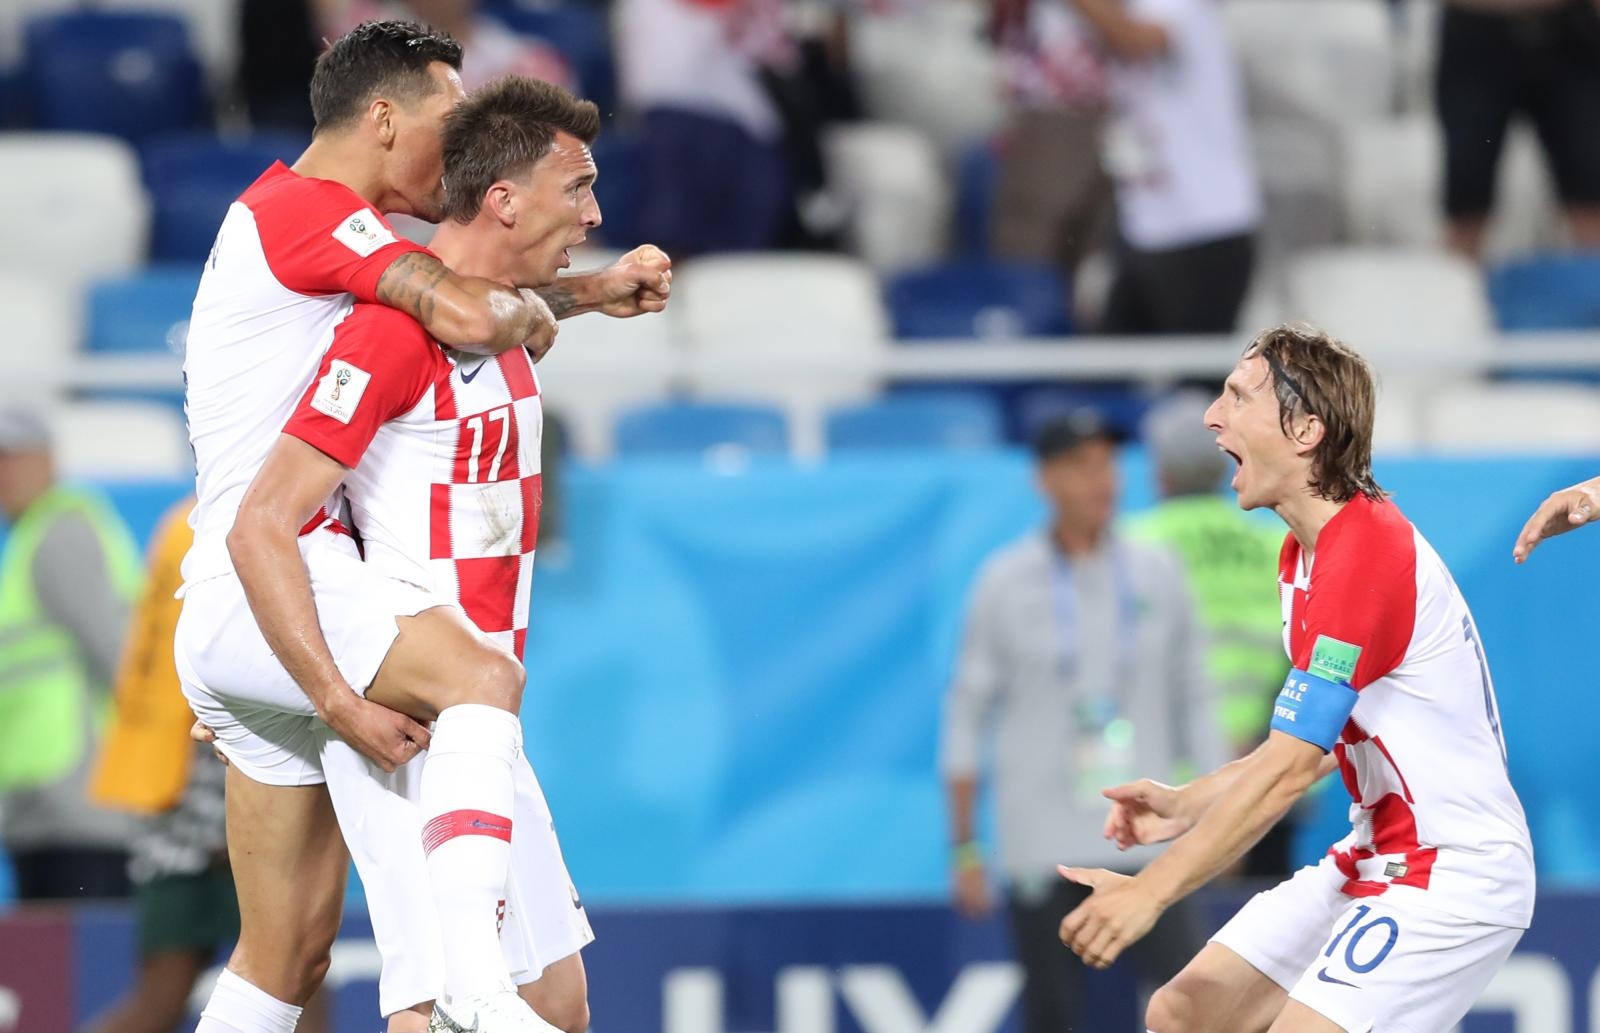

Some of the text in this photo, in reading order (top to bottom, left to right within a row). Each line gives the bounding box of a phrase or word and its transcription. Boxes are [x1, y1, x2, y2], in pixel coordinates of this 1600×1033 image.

[466, 406, 510, 483] 17
[1274, 705, 1297, 721] FIFA
[1324, 904, 1399, 974] 10
